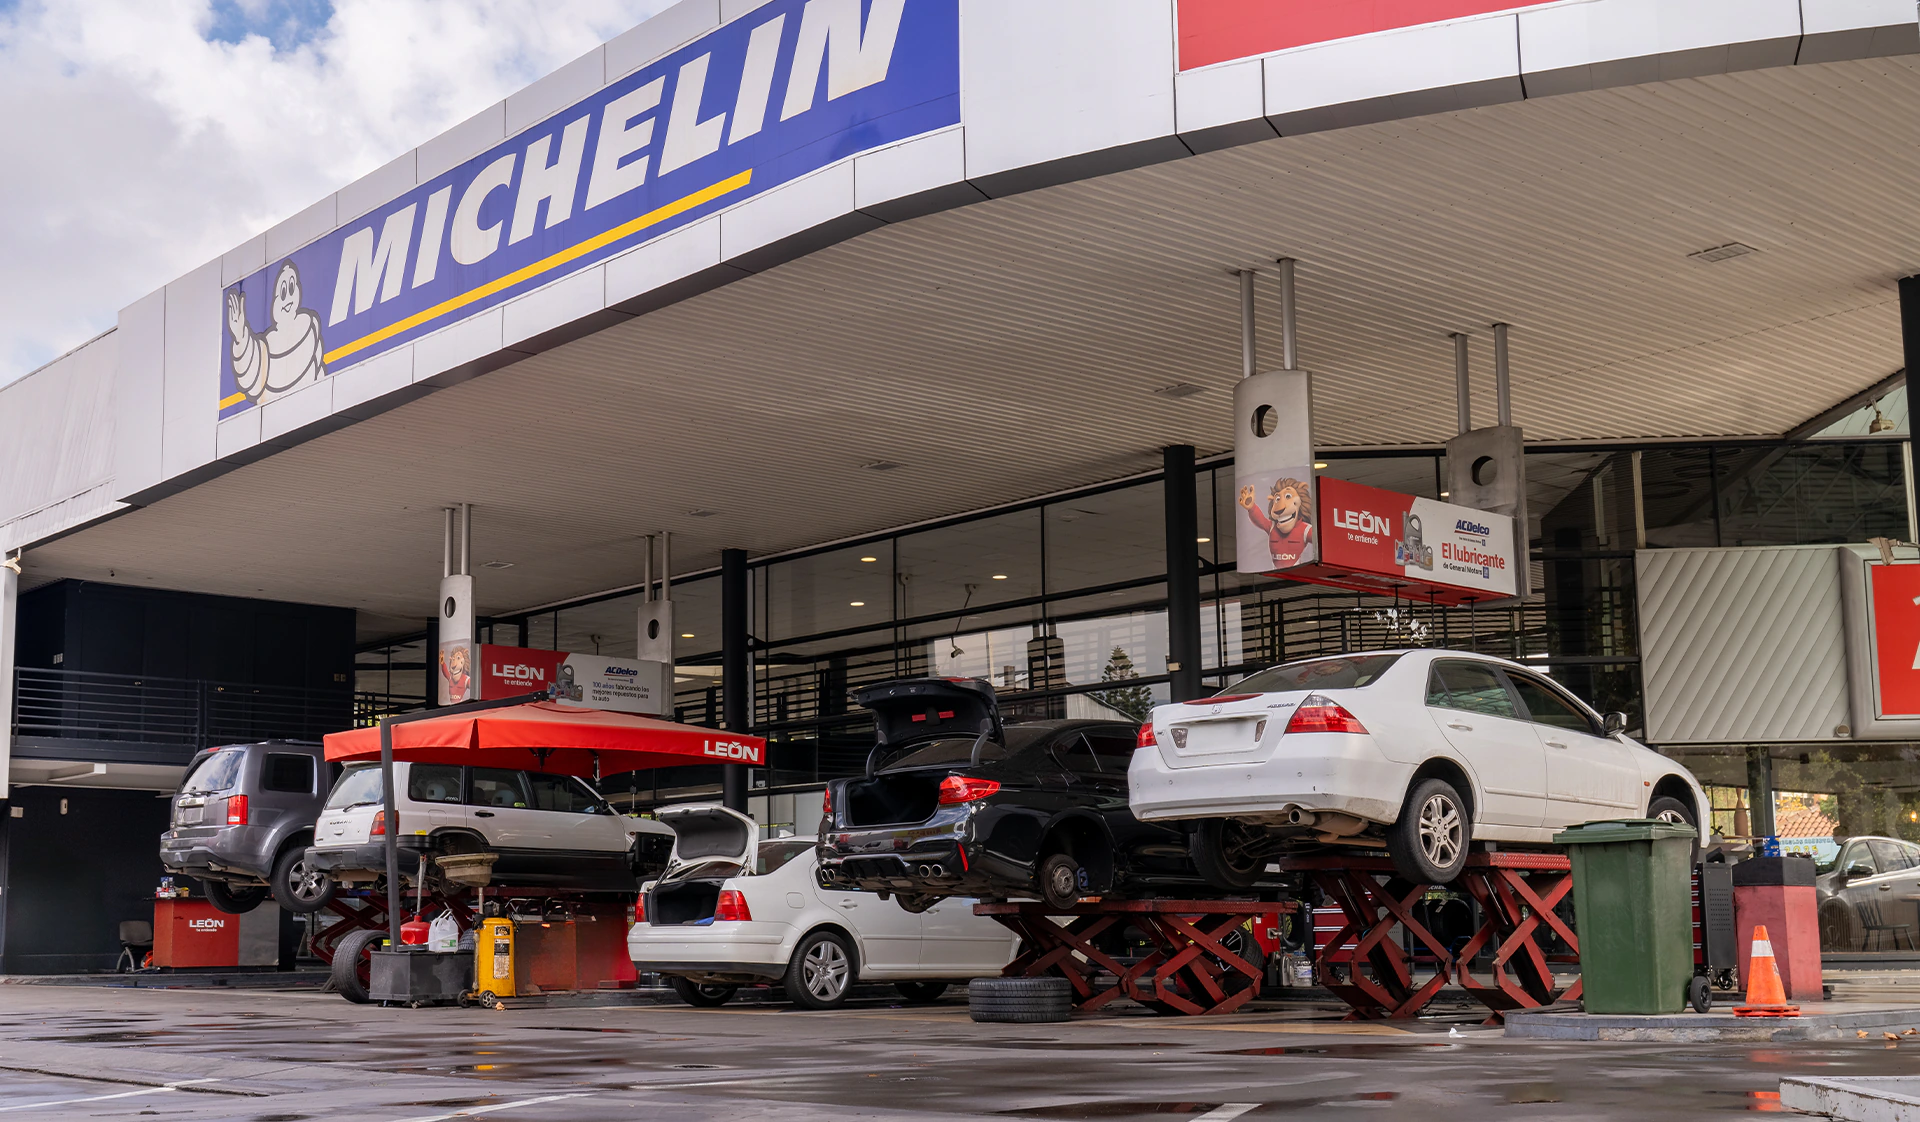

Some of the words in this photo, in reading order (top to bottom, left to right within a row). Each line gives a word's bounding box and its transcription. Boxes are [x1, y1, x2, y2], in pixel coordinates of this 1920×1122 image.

[328, 0, 904, 328] MICHELIN
[1455, 519, 1490, 535] ACDelco
[1347, 532, 1354, 541] te
[1355, 534, 1378, 546] entiende
[1441, 542, 1452, 560] El
[1453, 543, 1506, 570] lubricante
[1442, 561, 1449, 570] de
[1449, 562, 1467, 573] General
[1467, 565, 1483, 576] Motors
[605, 666, 638, 676] ACDelco
[615, 683, 641, 692] fabricando
[613, 690, 637, 698] repuestos
[637, 692, 649, 700] para
